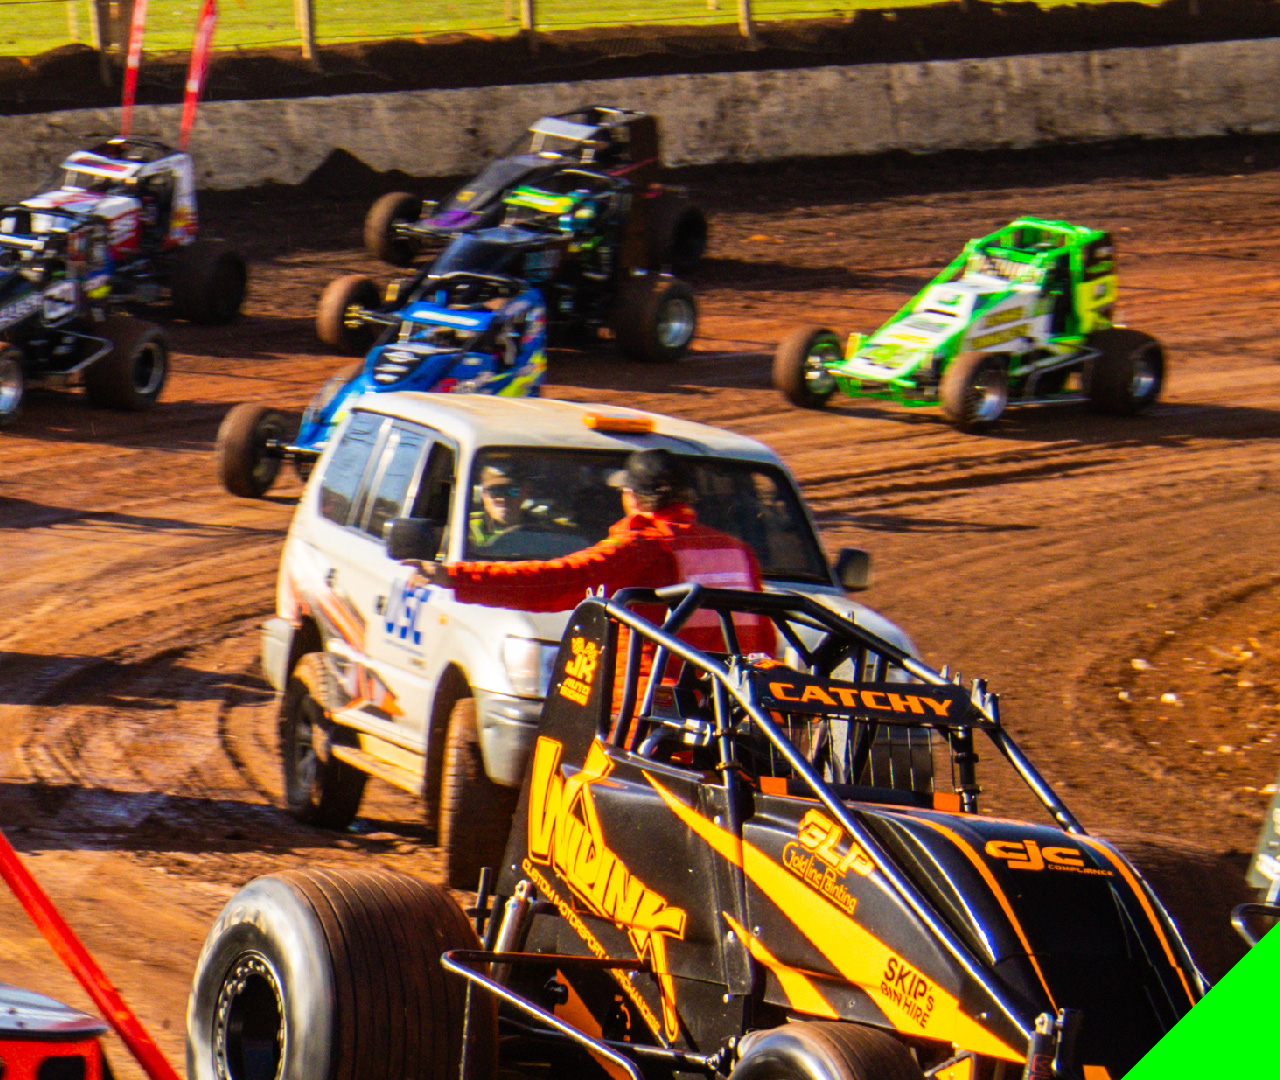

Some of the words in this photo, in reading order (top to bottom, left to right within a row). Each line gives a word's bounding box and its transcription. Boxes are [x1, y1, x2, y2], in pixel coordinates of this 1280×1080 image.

[769, 681, 952, 717] CATCHY
[798, 808, 875, 877] GLP
[881, 980, 902, 1007] BIN
[902, 996, 930, 1029] HIRE
